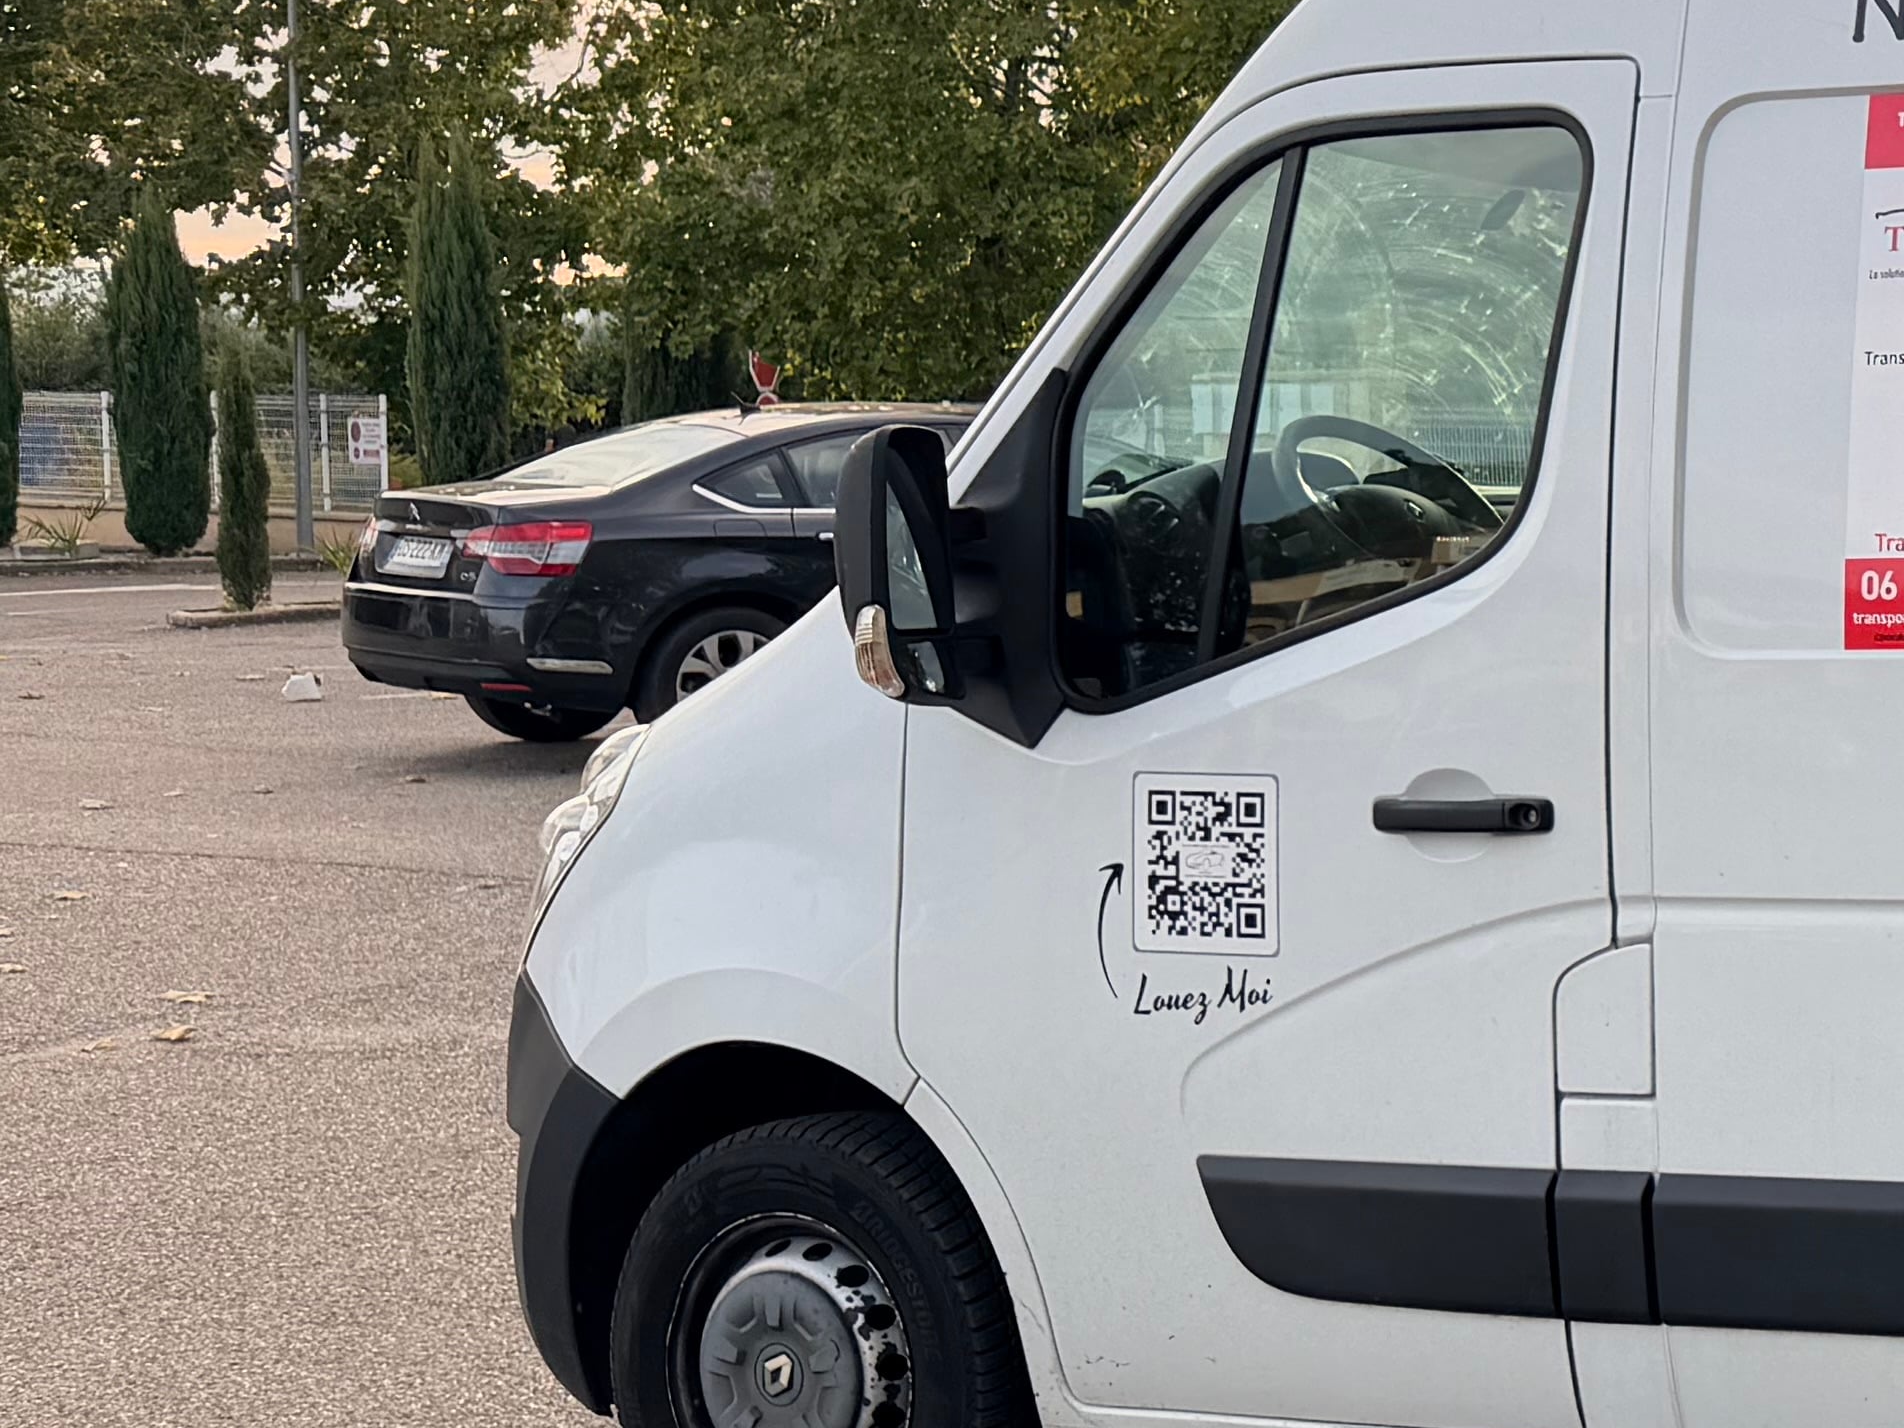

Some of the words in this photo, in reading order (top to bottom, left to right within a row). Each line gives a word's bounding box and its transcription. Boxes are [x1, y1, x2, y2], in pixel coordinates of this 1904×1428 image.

[1861, 570, 1898, 601] 06
[1133, 972, 1212, 1025] Louez
[1217, 964, 1273, 1014] Moi
